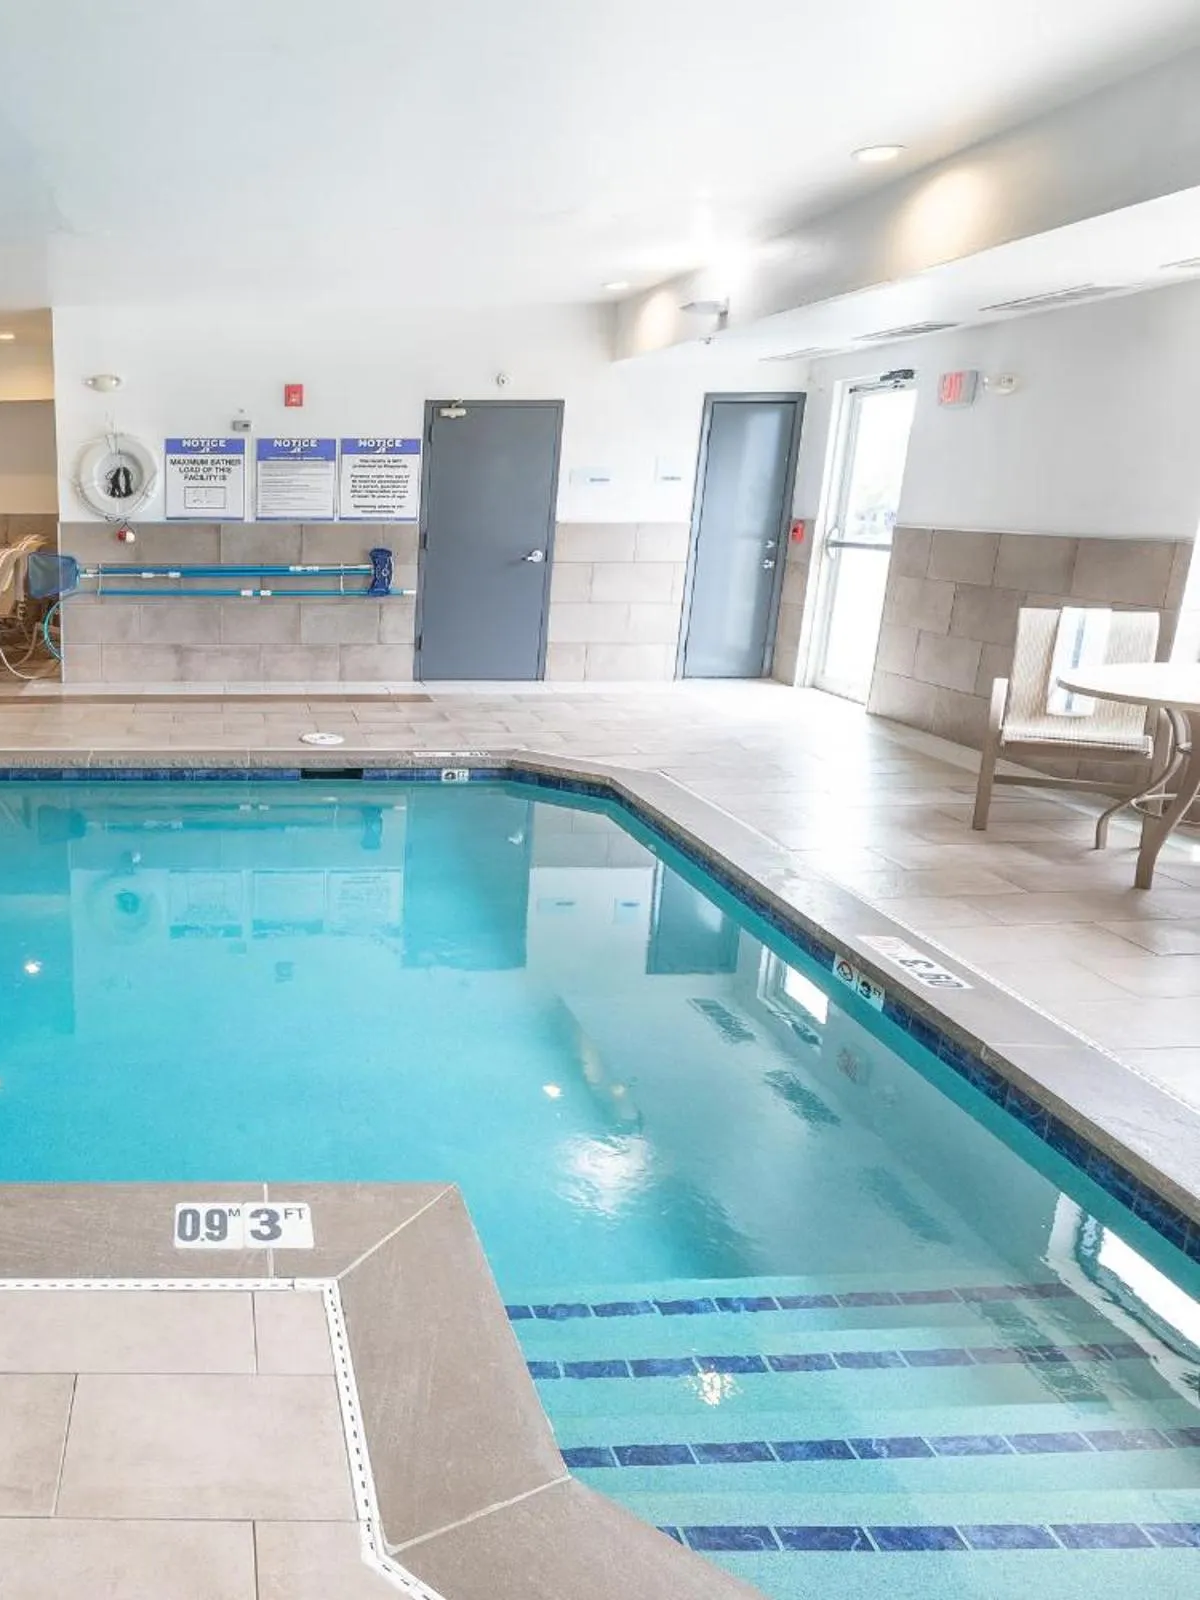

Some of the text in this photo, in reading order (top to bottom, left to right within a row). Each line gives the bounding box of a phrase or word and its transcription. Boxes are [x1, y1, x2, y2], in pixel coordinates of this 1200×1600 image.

[181, 439, 227, 448] NOTICE
[273, 439, 318, 448] NOTICE
[358, 439, 403, 448] NOTICE
[249, 1208, 283, 1242] 3
[284, 1208, 306, 1220] FT
